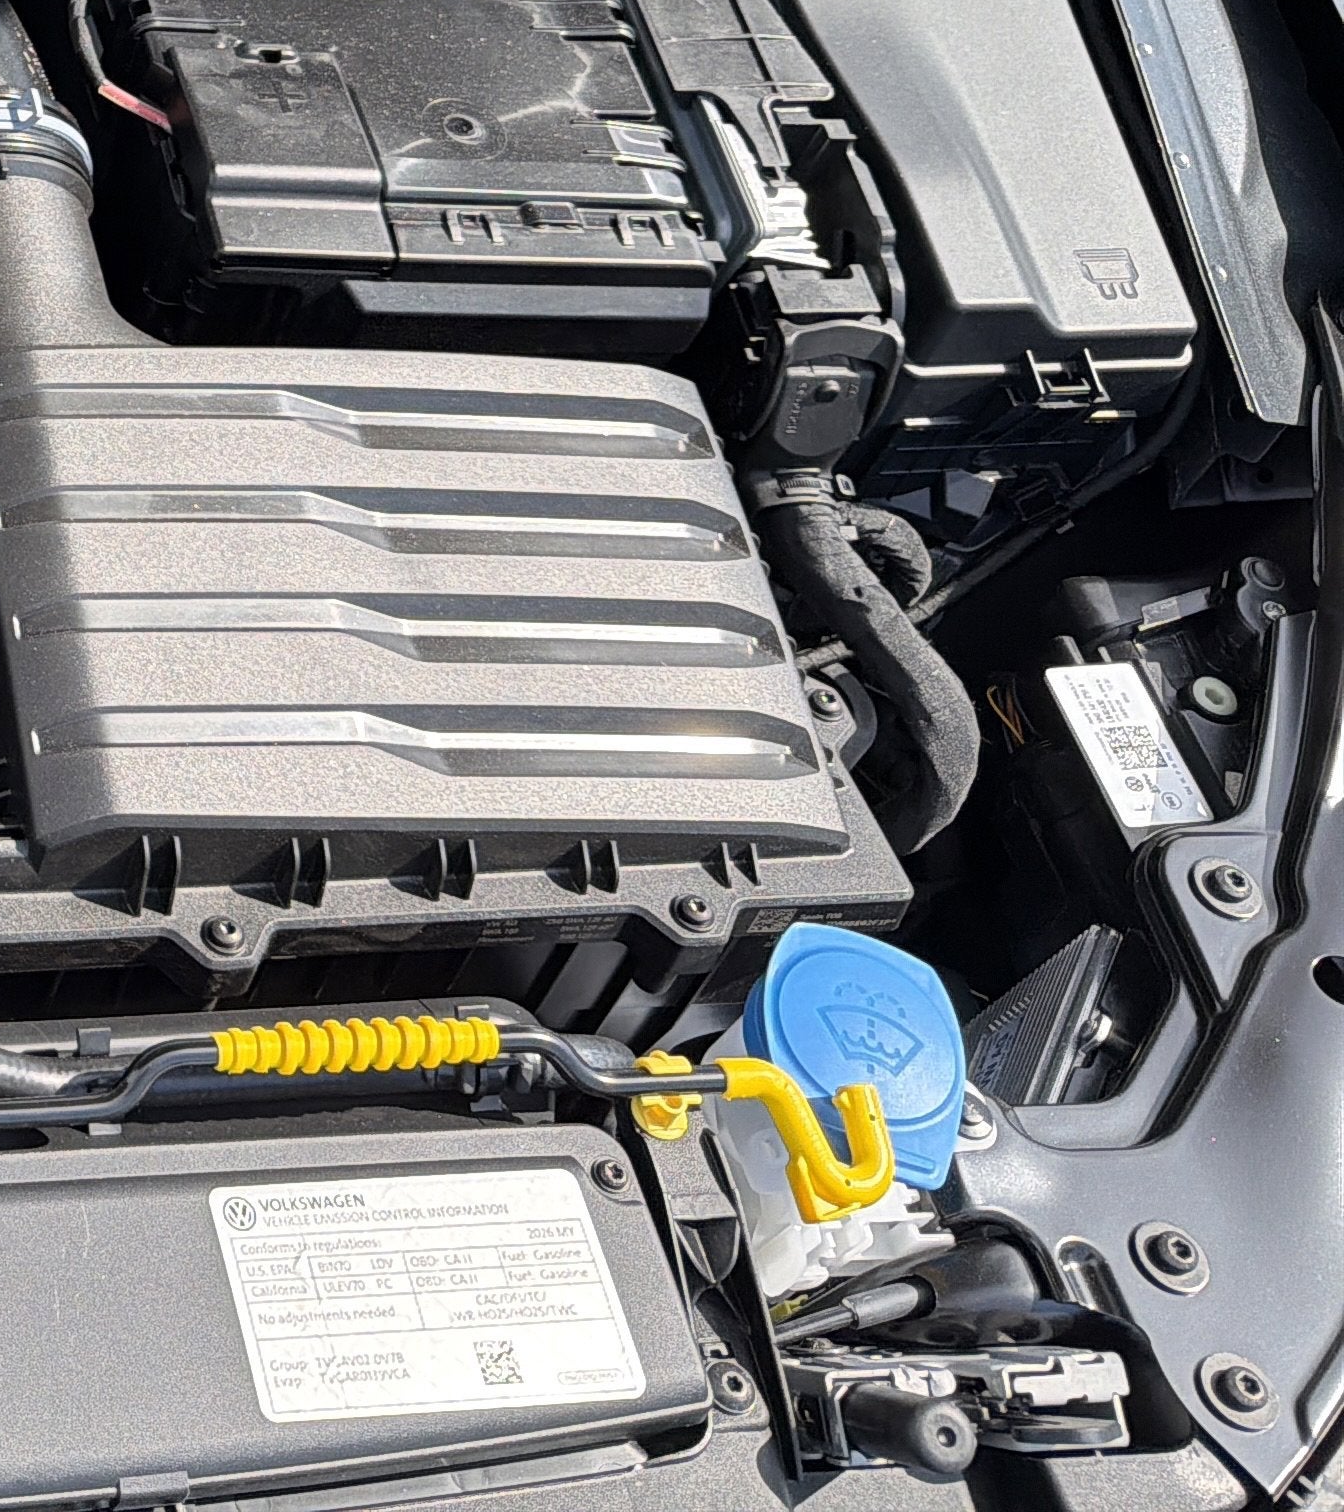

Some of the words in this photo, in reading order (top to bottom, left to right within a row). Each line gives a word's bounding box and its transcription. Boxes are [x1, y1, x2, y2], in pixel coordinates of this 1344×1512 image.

[258, 1194, 365, 1212] VOLKSWAGEN
[372, 1208, 427, 1221] CONTROL
[428, 1203, 509, 1218] INFORMATION
[246, 1266, 269, 1277] U.S.
[258, 1313, 275, 1325] No
[353, 1305, 395, 1319] needed
